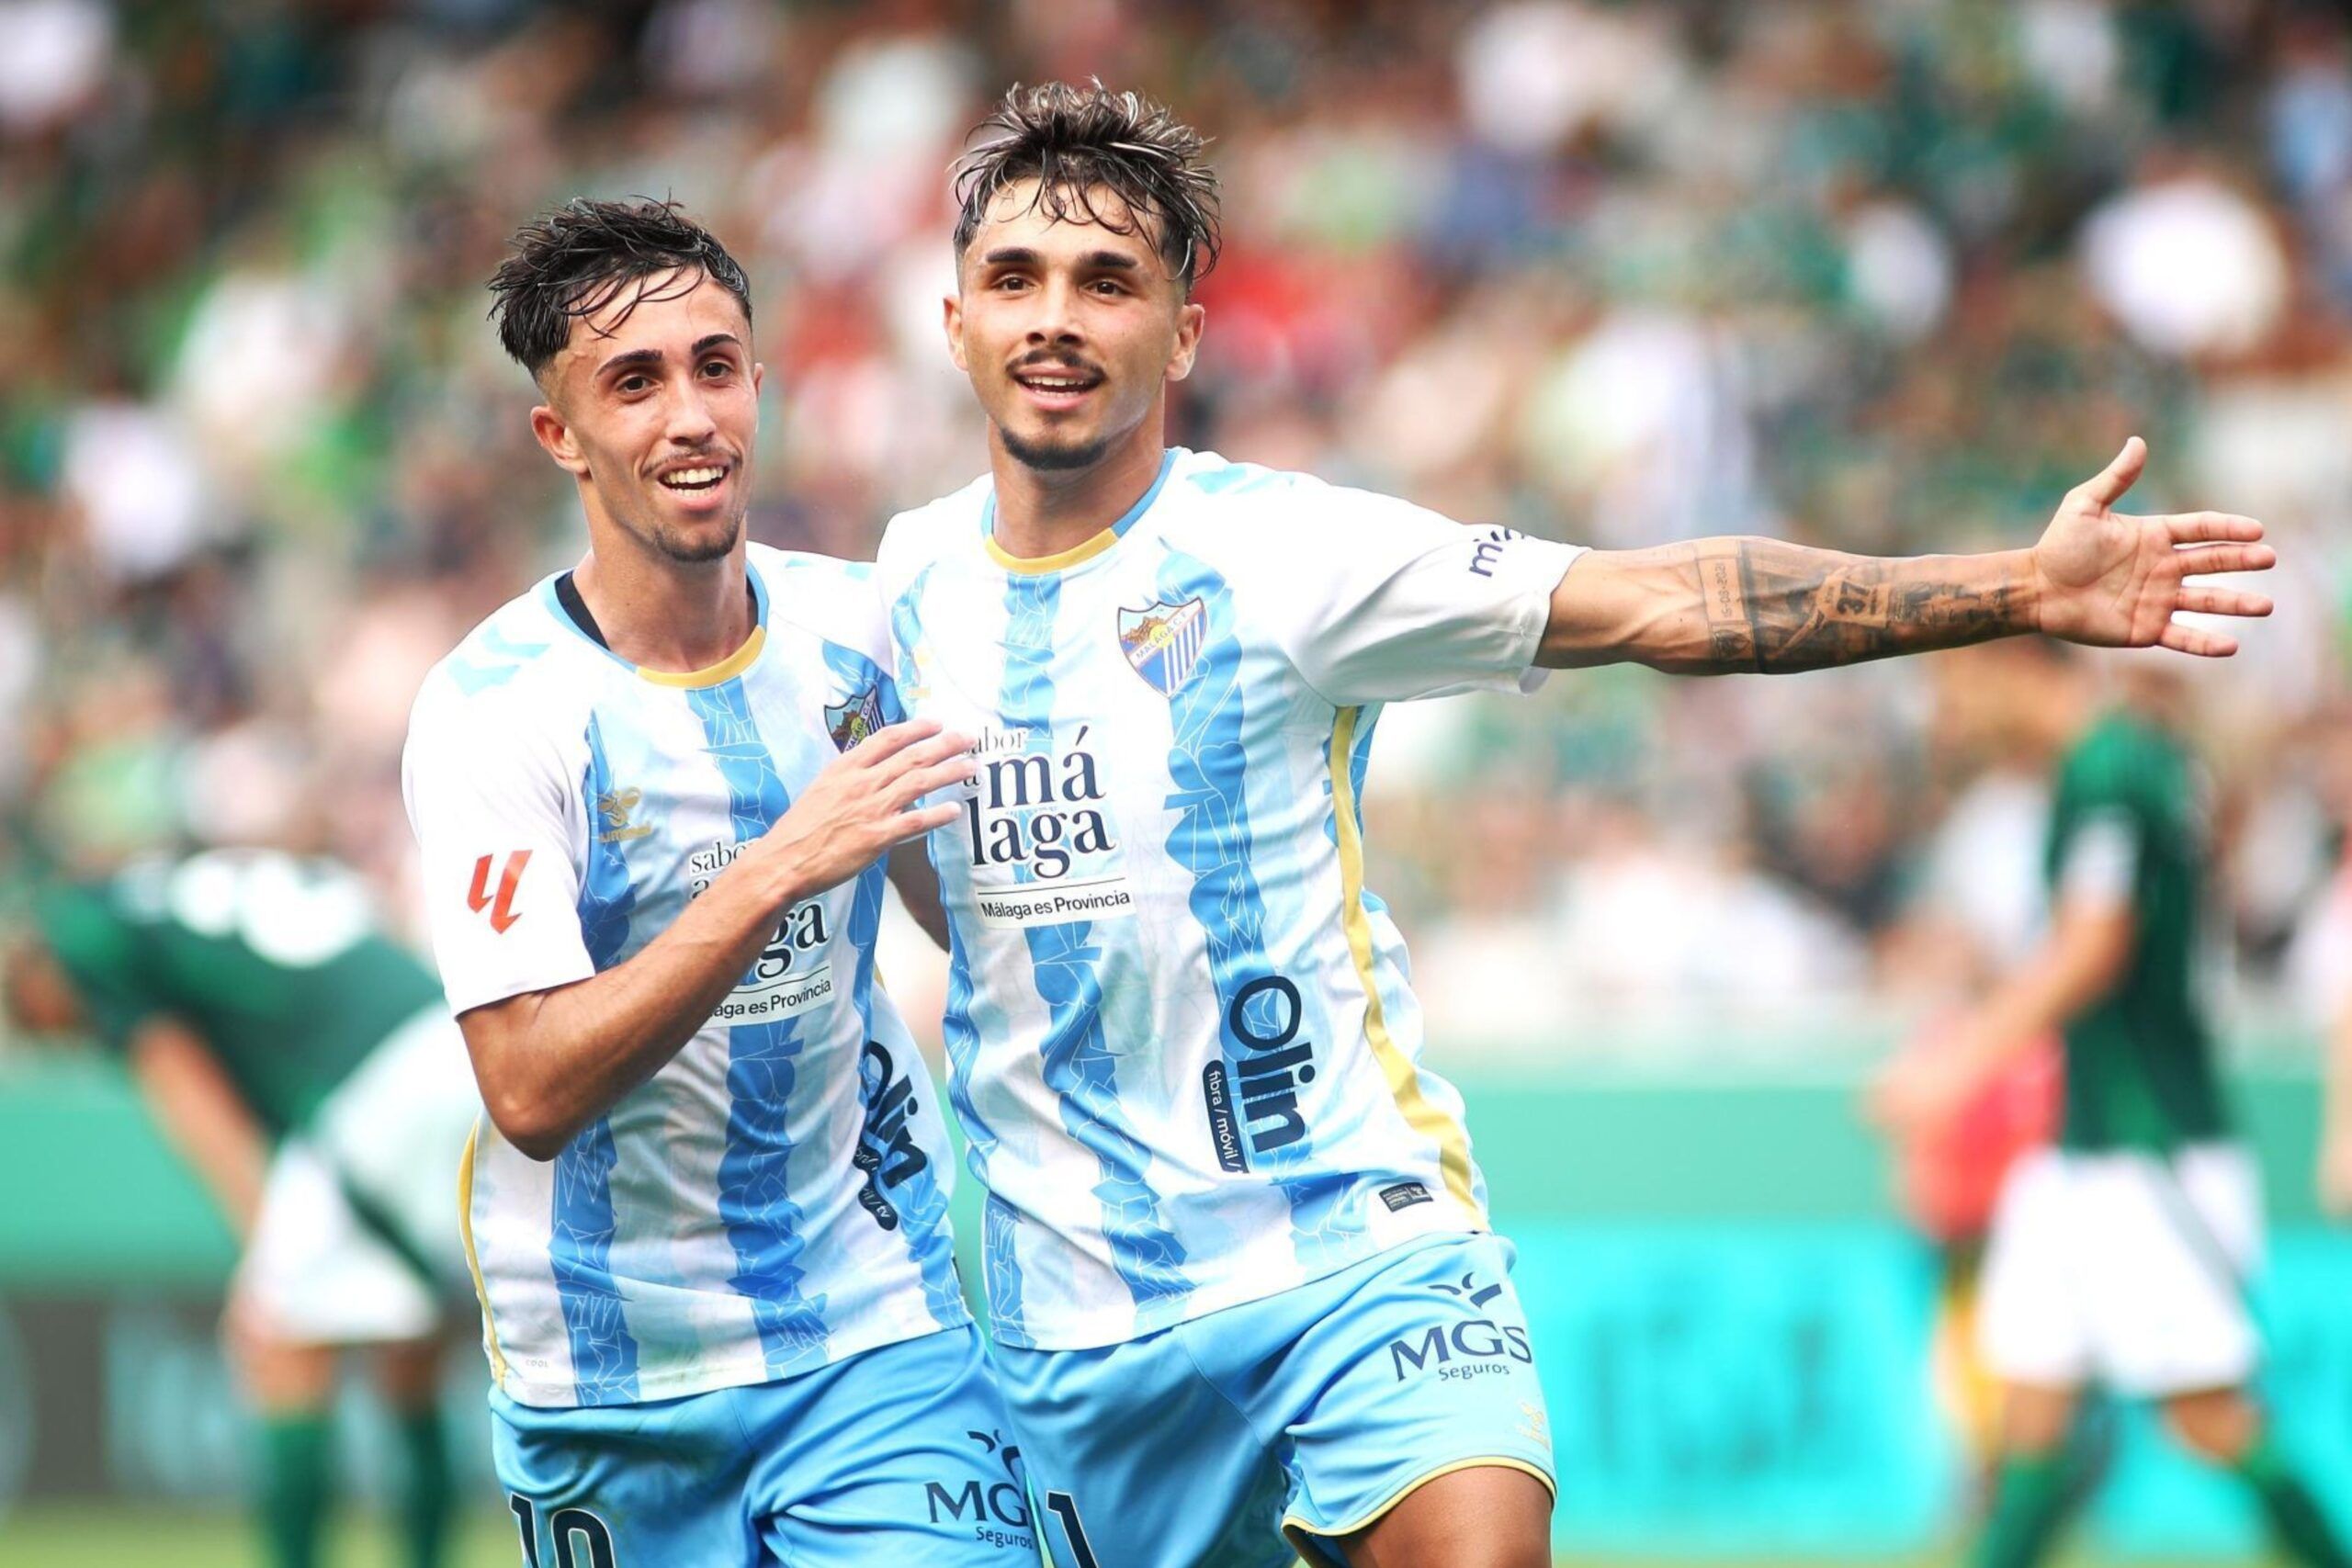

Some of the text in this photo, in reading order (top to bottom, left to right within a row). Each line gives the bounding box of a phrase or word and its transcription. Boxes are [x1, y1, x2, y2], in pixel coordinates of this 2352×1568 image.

[989, 725, 1108, 809] má
[971, 796, 1116, 878] laga
[981, 888, 1131, 919] Málaga es Provincia
[749, 1001, 768, 1014] es
[770, 978, 831, 1011] Provincia
[1229, 975, 1316, 1153] Olin
[1208, 1070, 1223, 1106] fibra
[1216, 1116, 1238, 1160] móvil
[876, 1204, 891, 1219] tv
[525, 1359, 549, 1368] COOL
[1389, 1319, 1532, 1382] MGS
[1438, 1359, 1510, 1382] Seguros
[924, 1480, 1030, 1528] MG
[509, 1491, 617, 1568] 10
[975, 1525, 1035, 1551] Seguros
